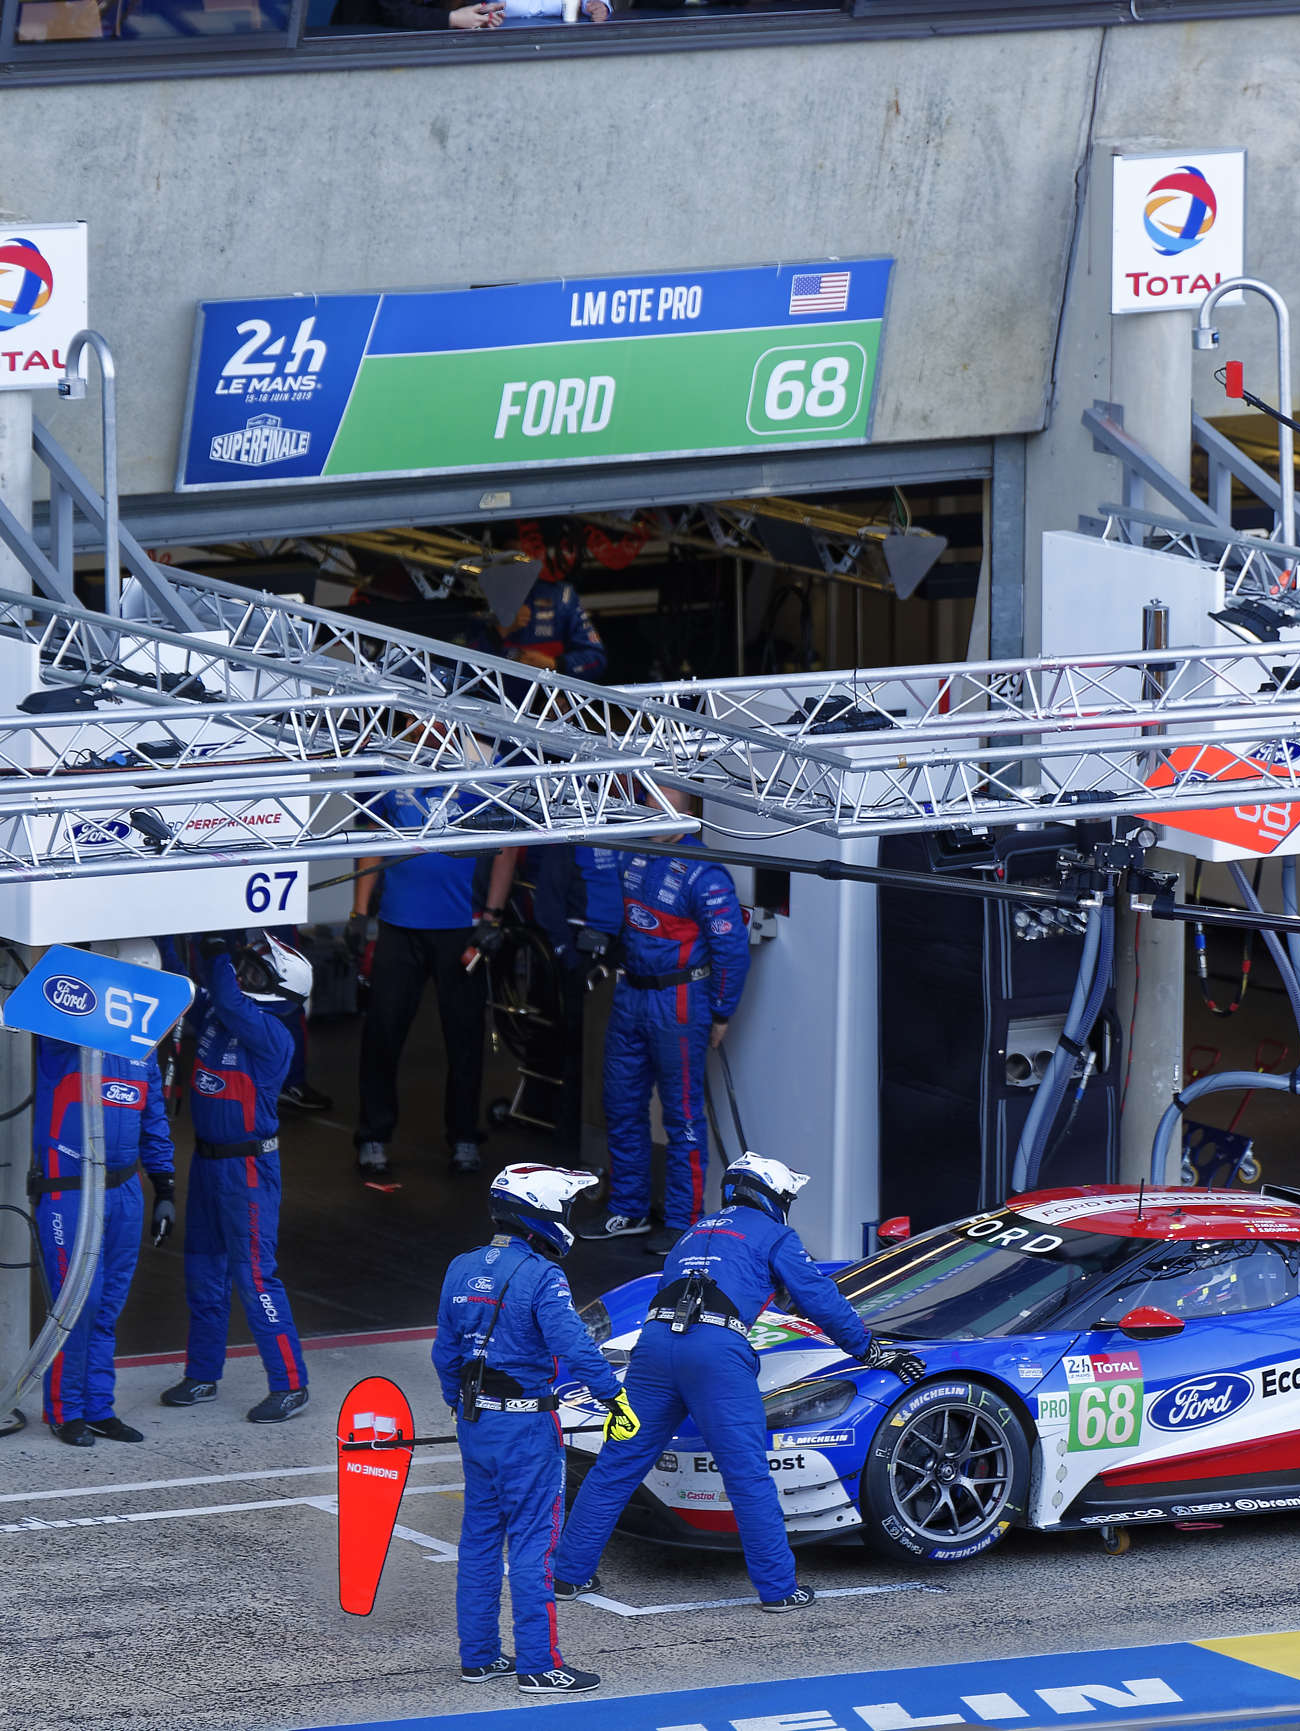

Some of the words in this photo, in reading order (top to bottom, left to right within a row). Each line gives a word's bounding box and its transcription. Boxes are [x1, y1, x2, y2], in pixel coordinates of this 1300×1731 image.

[570, 290, 607, 327] LM
[611, 287, 655, 325] GTE
[657, 284, 702, 321] PRO
[215, 378, 246, 395] LE
[249, 375, 317, 393] MANS
[764, 356, 850, 421] 68
[494, 375, 616, 439] FORD
[212, 426, 309, 463] SUPERFINALE
[245, 870, 298, 913] 67
[53, 978, 87, 1010] Ford
[105, 987, 160, 1034] 67
[106, 1083, 140, 1105] Ford
[1041, 1201, 1100, 1218] FORD
[52, 1212, 65, 1246] FORD
[259, 1293, 280, 1323] FORD
[1093, 1361, 1139, 1374] TOTAL
[909, 1386, 966, 1412] MICHELIN
[1040, 1398, 1068, 1419] PRO
[1168, 1381, 1232, 1425] Ford
[1078, 1384, 1136, 1447] 68
[797, 1433, 849, 1444] MICHELIN
[346, 1461, 362, 1473] ON
[362, 1464, 398, 1480] ENGINE
[686, 1491, 716, 1501] Castrol
[1080, 1507, 1164, 1525] sparco
[934, 1536, 992, 1559] MICHELIN
[656, 1677, 1184, 1731] ELIN
